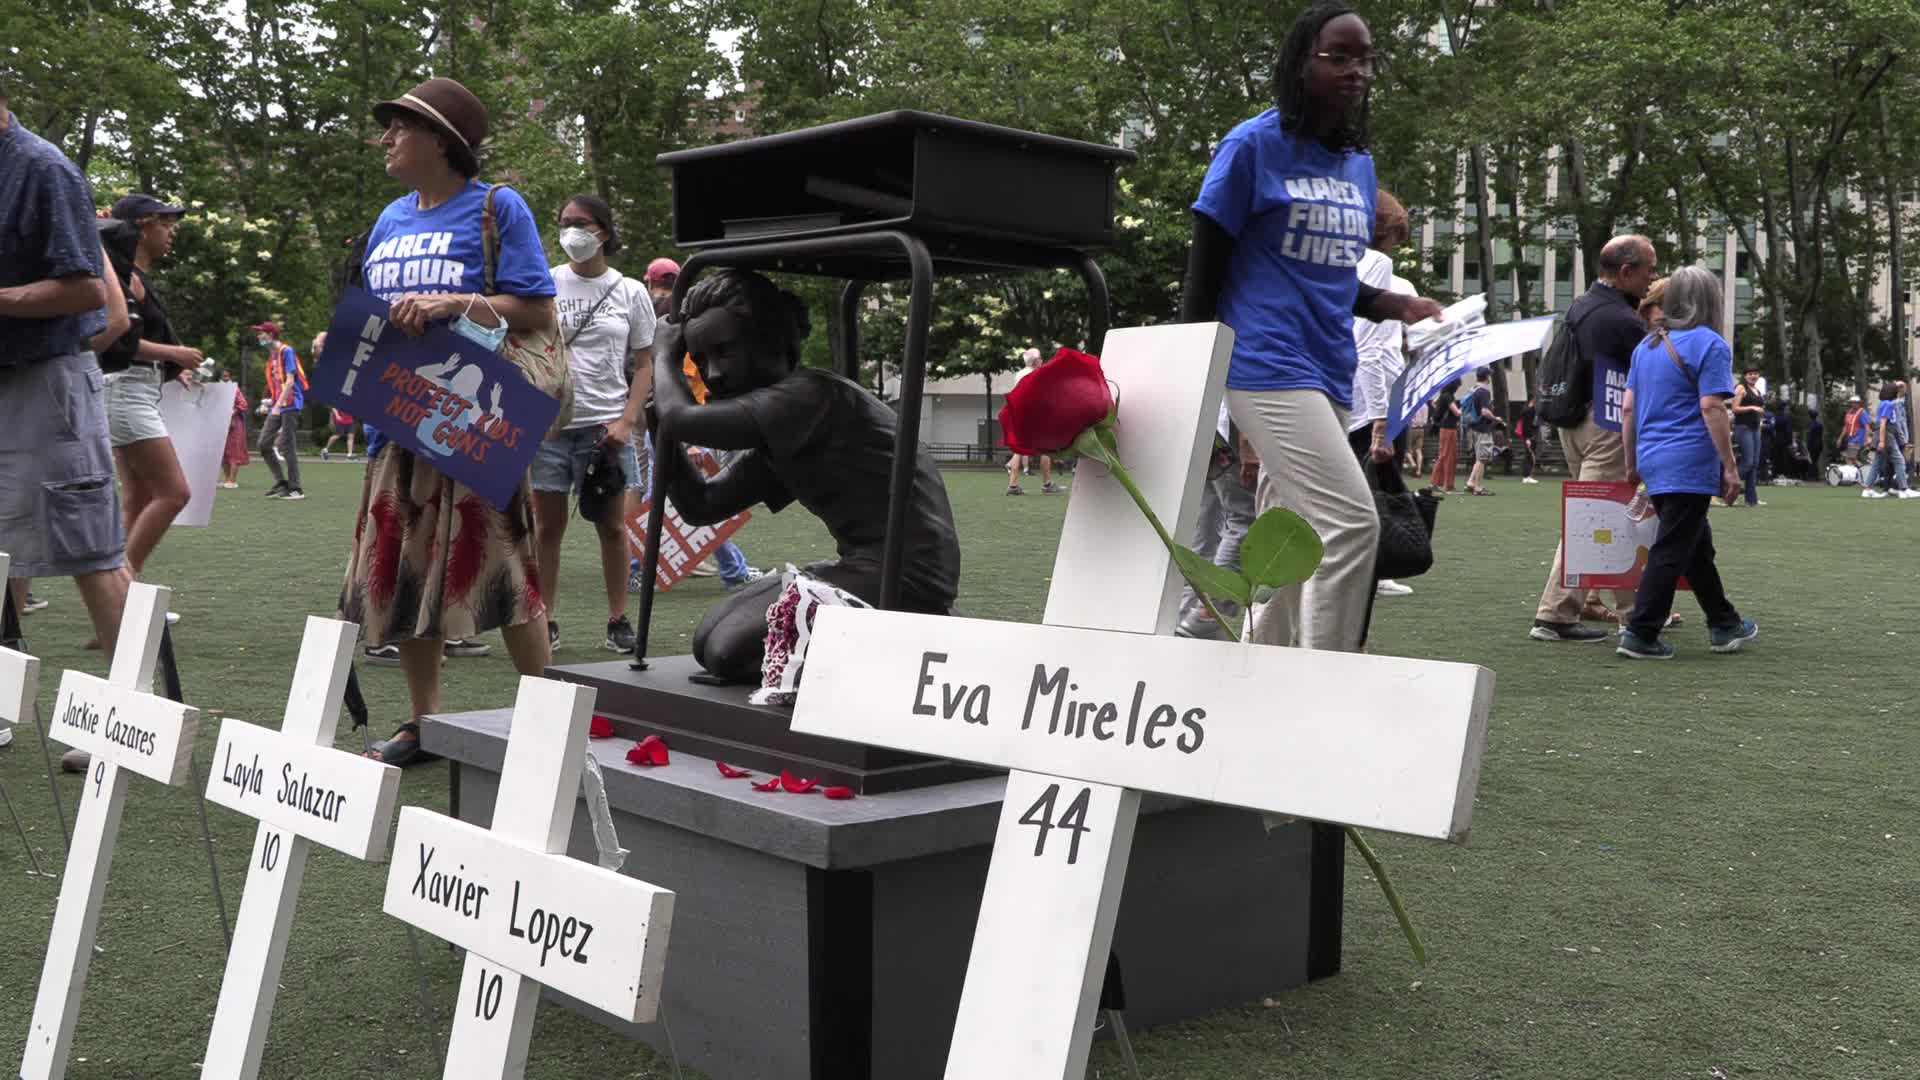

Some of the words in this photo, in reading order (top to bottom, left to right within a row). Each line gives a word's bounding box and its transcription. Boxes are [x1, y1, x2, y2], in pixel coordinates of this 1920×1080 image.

[1288, 202, 1342, 234] FOR
[403, 258, 465, 287] OUR
[1281, 231, 1358, 267] LIVES
[559, 298, 584, 313] GHT
[379, 361, 474, 421] PROTECT
[475, 411, 523, 449] KIDS
[384, 395, 433, 427] NOT
[432, 420, 491, 463] GUNS
[62, 692, 99, 736] Jackie
[105, 705, 157, 757] Cazares
[911, 650, 992, 726] Eva
[1020, 662, 1207, 754] Mireles
[94, 760, 105, 798] 9
[223, 741, 264, 798] Layla
[277, 762, 347, 824] Salazar
[260, 831, 281, 872] 10
[1018, 783, 1091, 865] 44
[411, 842, 489, 920] Xavier
[509, 880, 594, 967] Lopez
[474, 968, 503, 1021] 10
